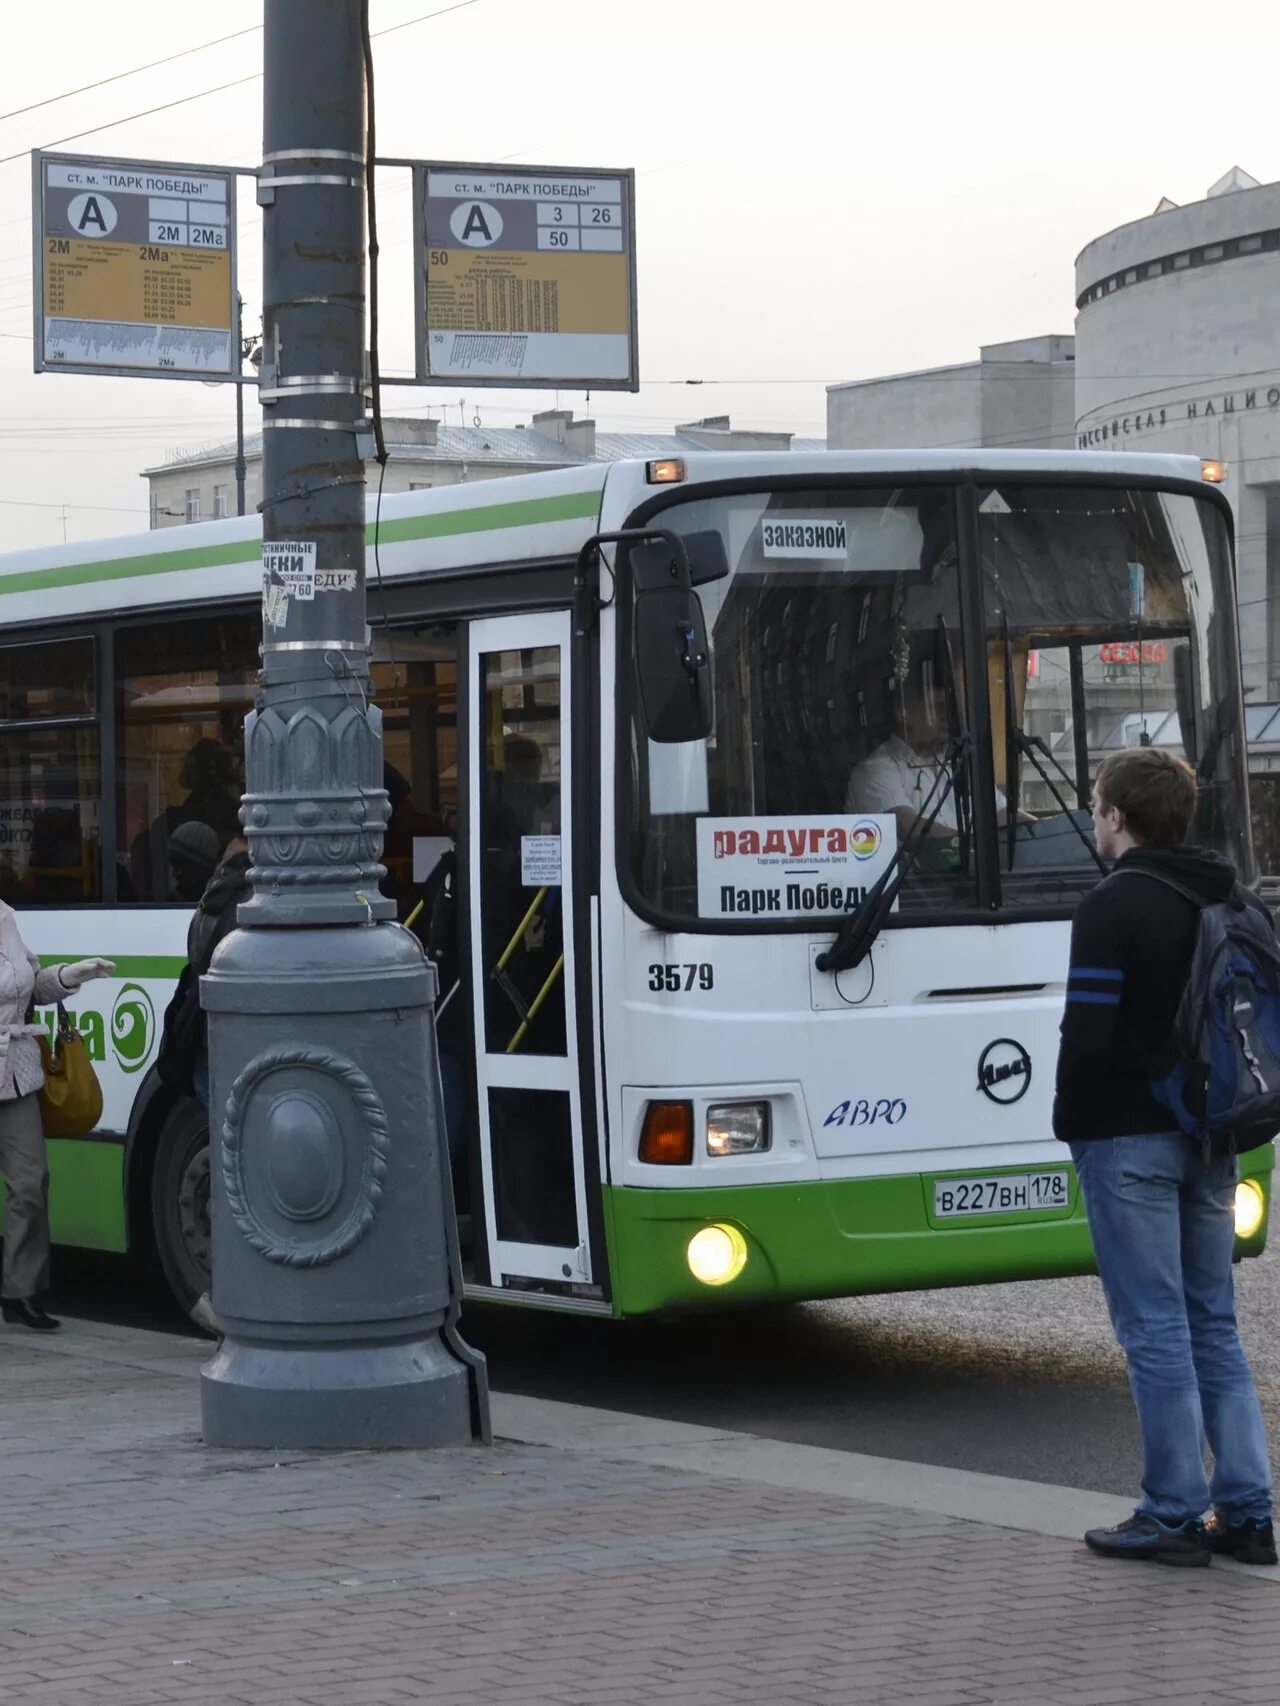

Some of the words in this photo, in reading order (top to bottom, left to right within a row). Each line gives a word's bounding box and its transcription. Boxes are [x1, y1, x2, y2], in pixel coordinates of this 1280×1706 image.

[67, 173, 83, 185] ст.
[86, 175, 99, 186] м.
[454, 183, 470, 193] ст.
[473, 184, 487, 194] м.
[78, 196, 108, 232] А
[461, 204, 493, 241] А
[553, 206, 563, 222] 3
[591, 207, 611, 224] 26
[157, 225, 180, 242] 2М
[192, 227, 224, 245] 2Ма
[549, 231, 569, 247] 50
[48, 239, 70, 255] 2М
[139, 246, 169, 262] 2Ма
[430, 251, 448, 266] 50
[433, 335, 444, 344] 50
[763, 519, 847, 550] заказной
[714, 827, 847, 859] радуга
[721, 885, 780, 914] Парк
[648, 963, 714, 992] 3579
[1031, 1175, 1062, 1196] 178
